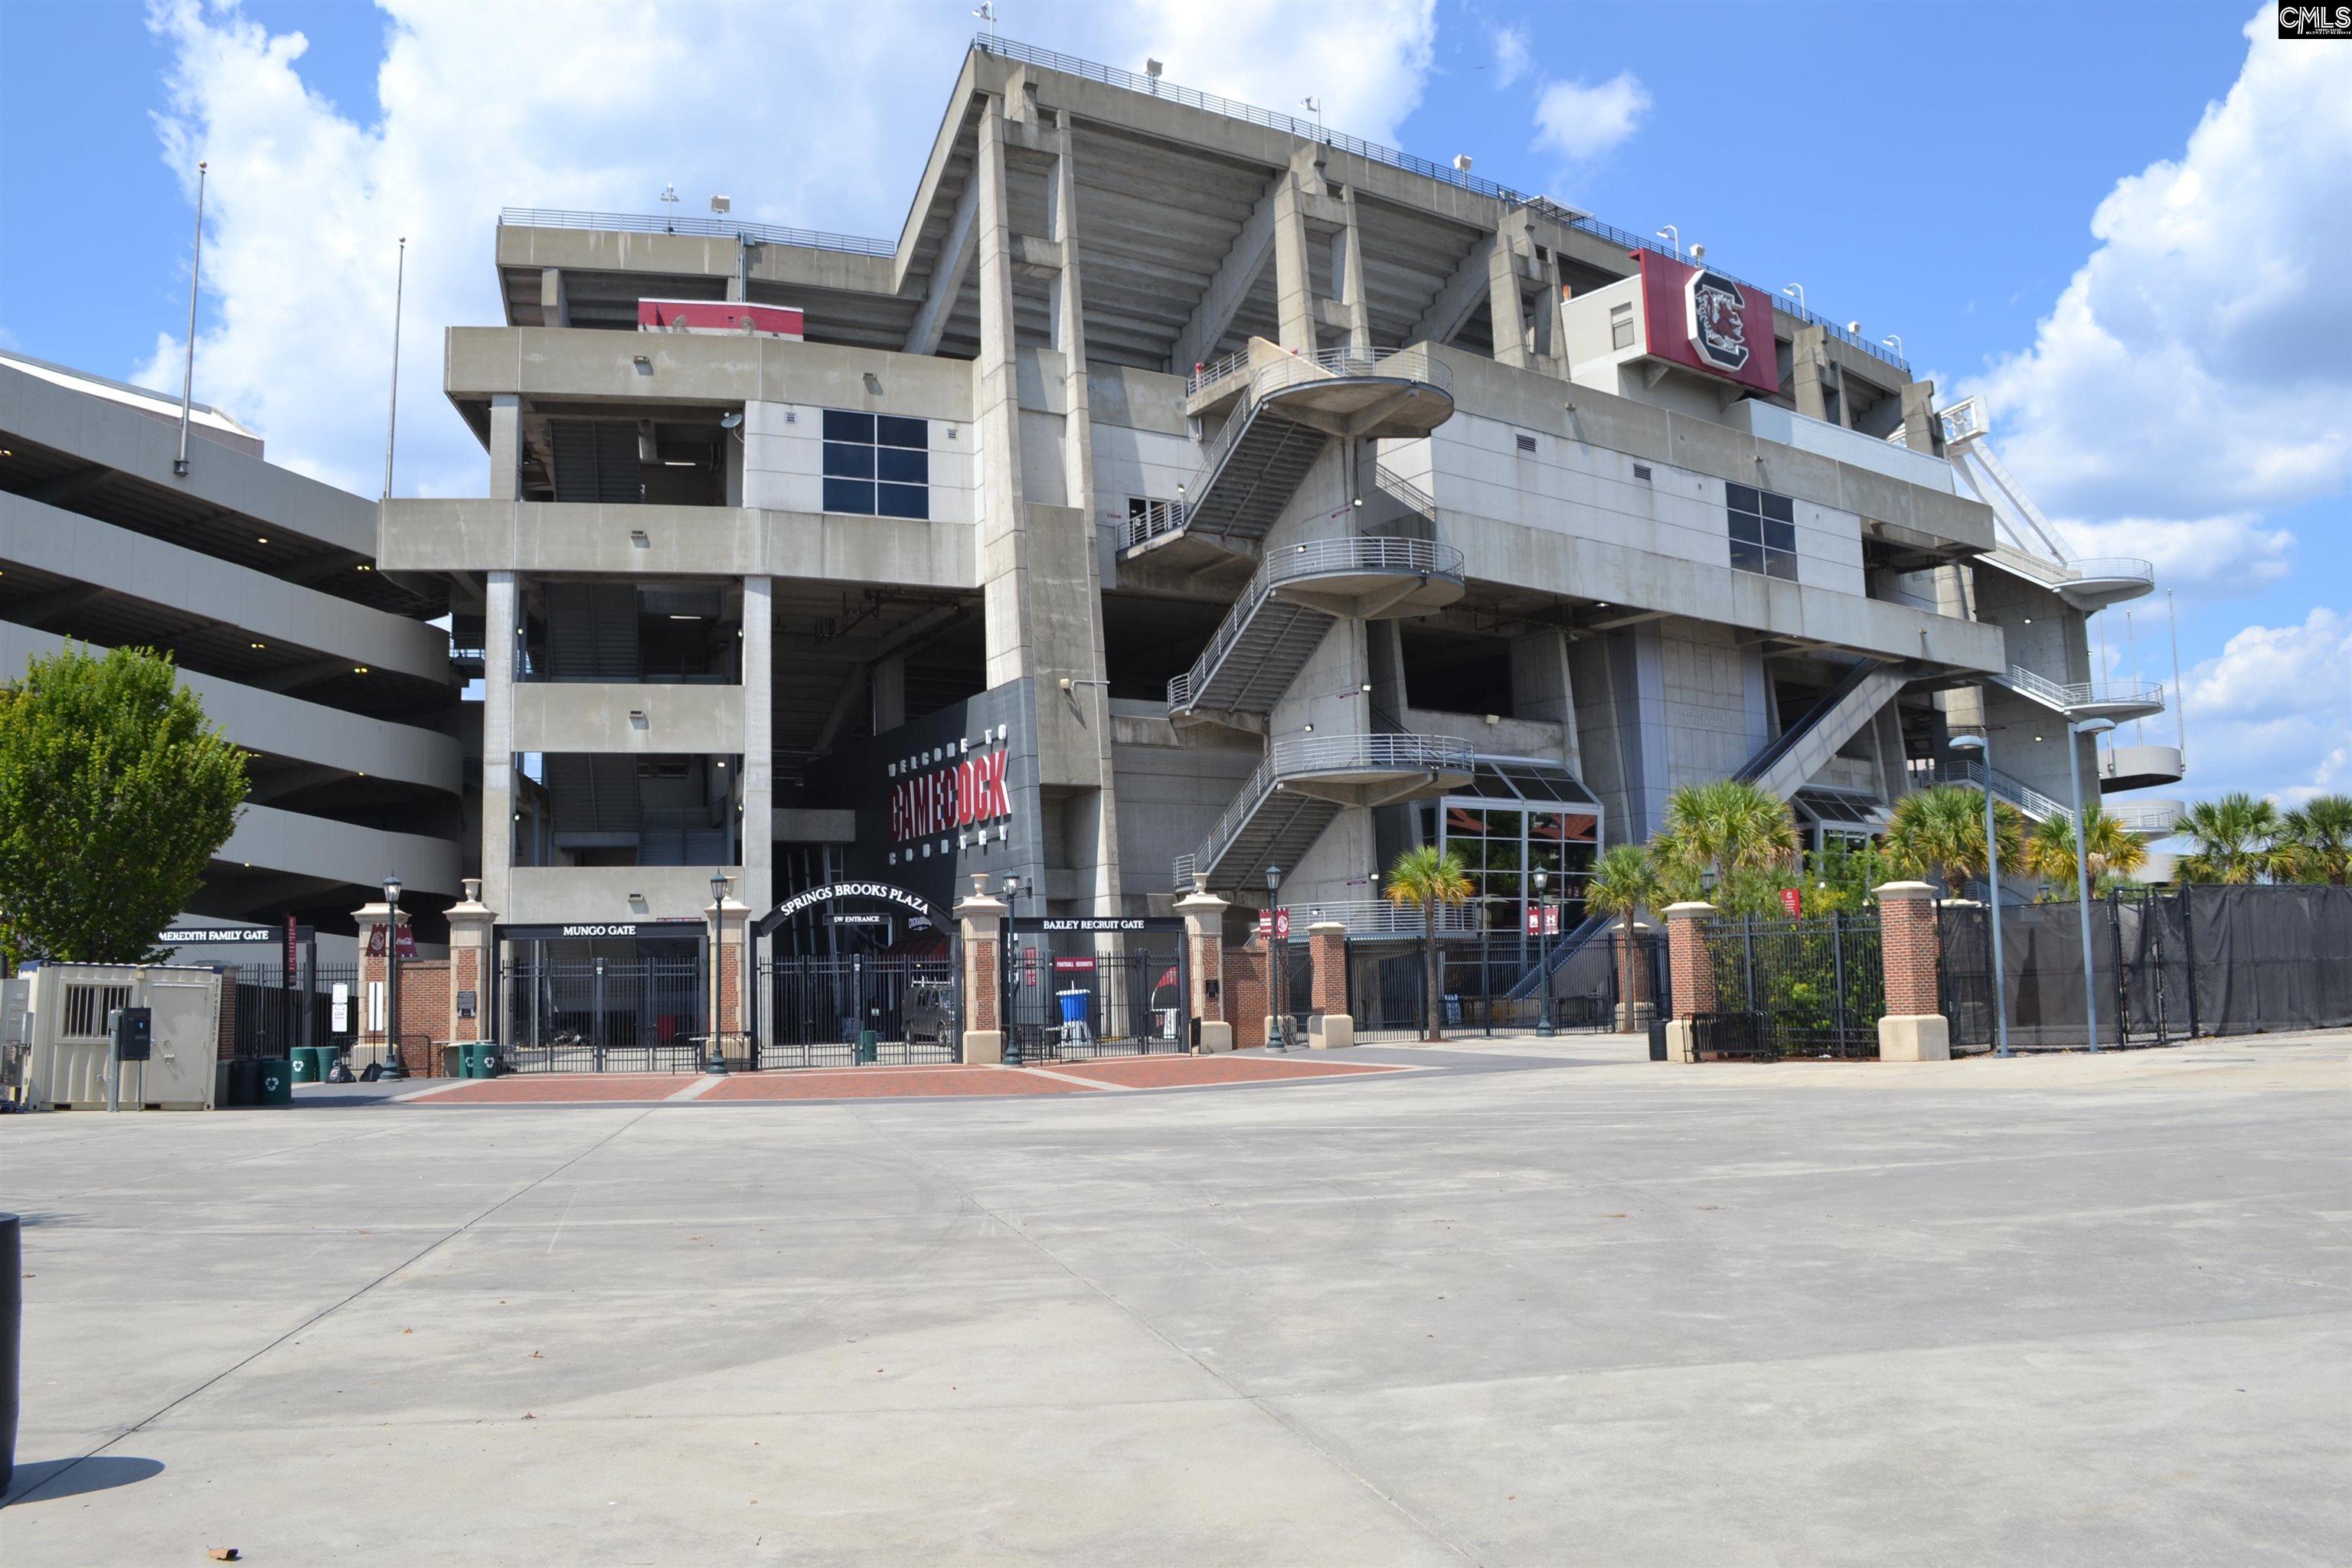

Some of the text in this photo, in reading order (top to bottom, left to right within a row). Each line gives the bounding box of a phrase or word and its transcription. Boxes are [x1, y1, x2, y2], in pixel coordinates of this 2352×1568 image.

[888, 724, 1007, 777] WELCOME TO
[889, 749, 1011, 841] GAMECOCK
[889, 825, 1008, 865] COUNTRY
[781, 884, 929, 916] SPRINGS BROOKS PLAZA
[158, 930, 269, 941] MEREDITH FAMILY GATE
[563, 926, 636, 936] MUNGO GATE
[1043, 920, 1145, 929] BAXLEY RECRUIT GATE
